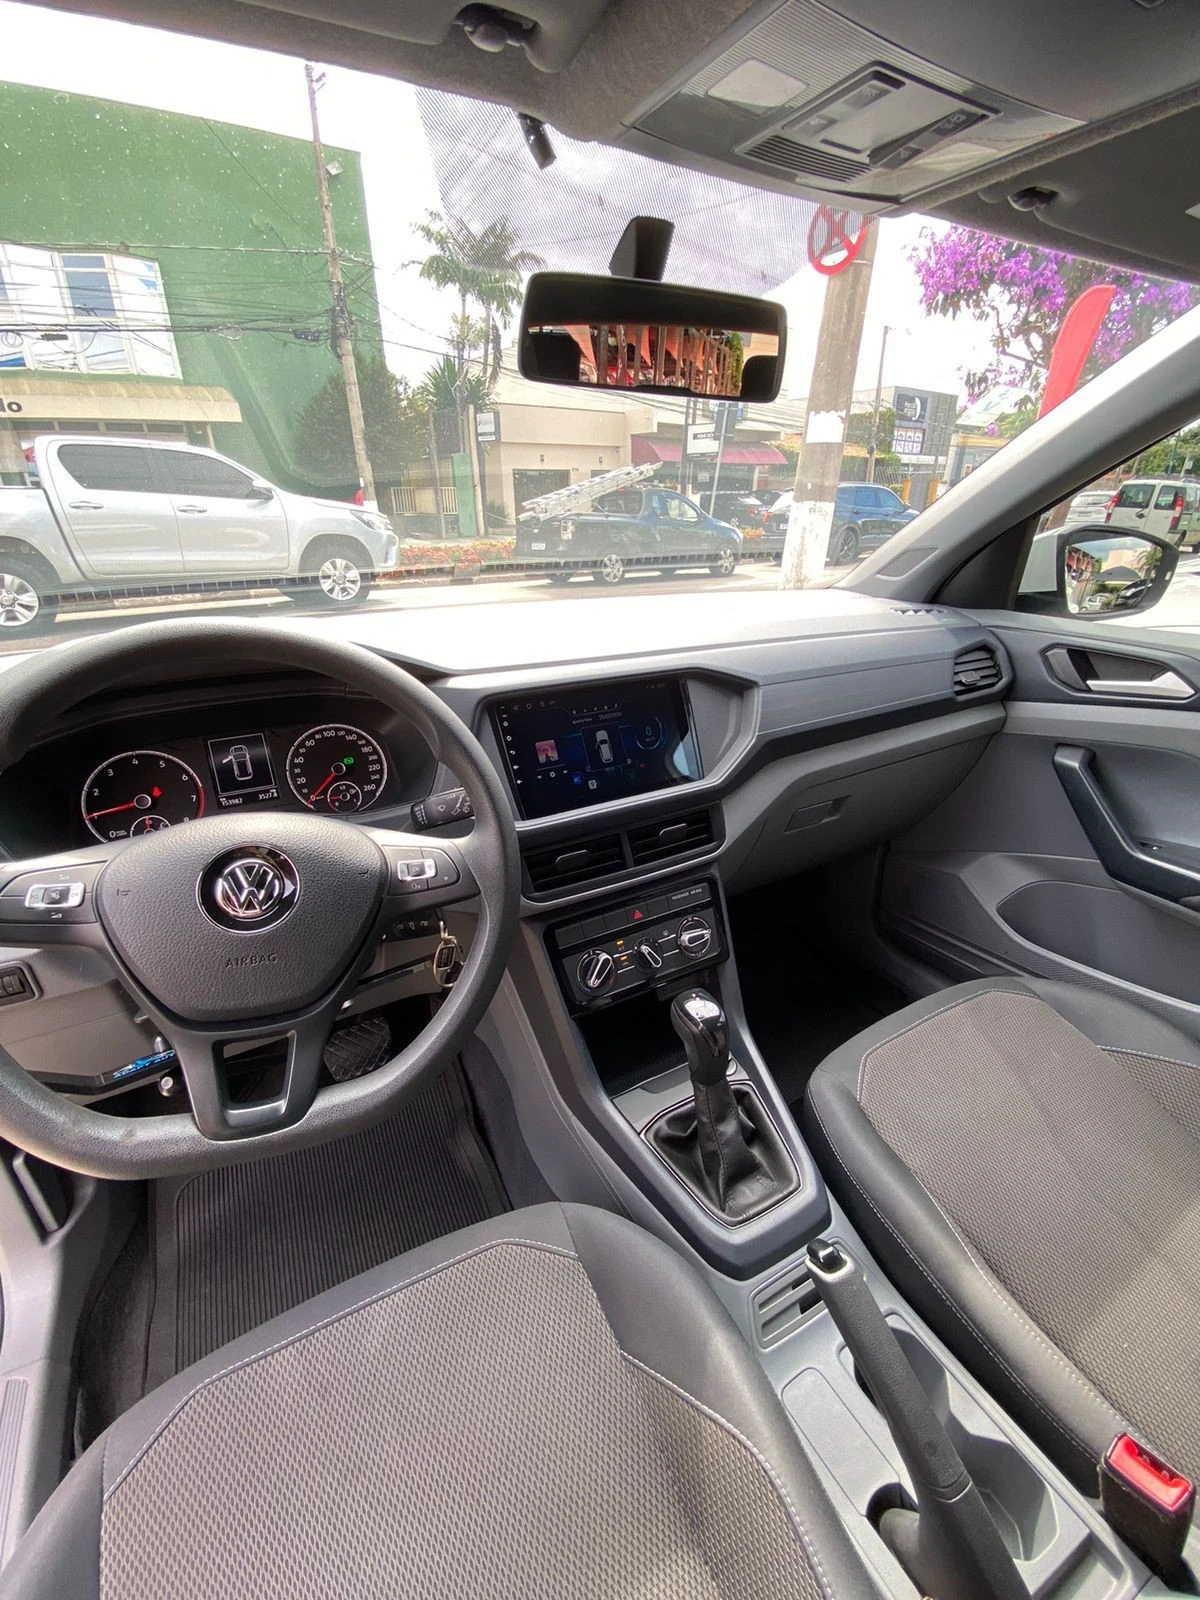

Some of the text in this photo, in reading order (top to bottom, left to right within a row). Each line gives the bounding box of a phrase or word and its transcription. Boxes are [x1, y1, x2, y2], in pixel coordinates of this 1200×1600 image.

[345, 733, 357, 741] 140
[368, 764, 380, 772] 220
[107, 769, 114, 777] 3
[363, 783, 376, 791] 260
[92, 788, 99, 796] 2
[109, 830, 116, 838] 0
[225, 952, 278, 969] AIRBAG
